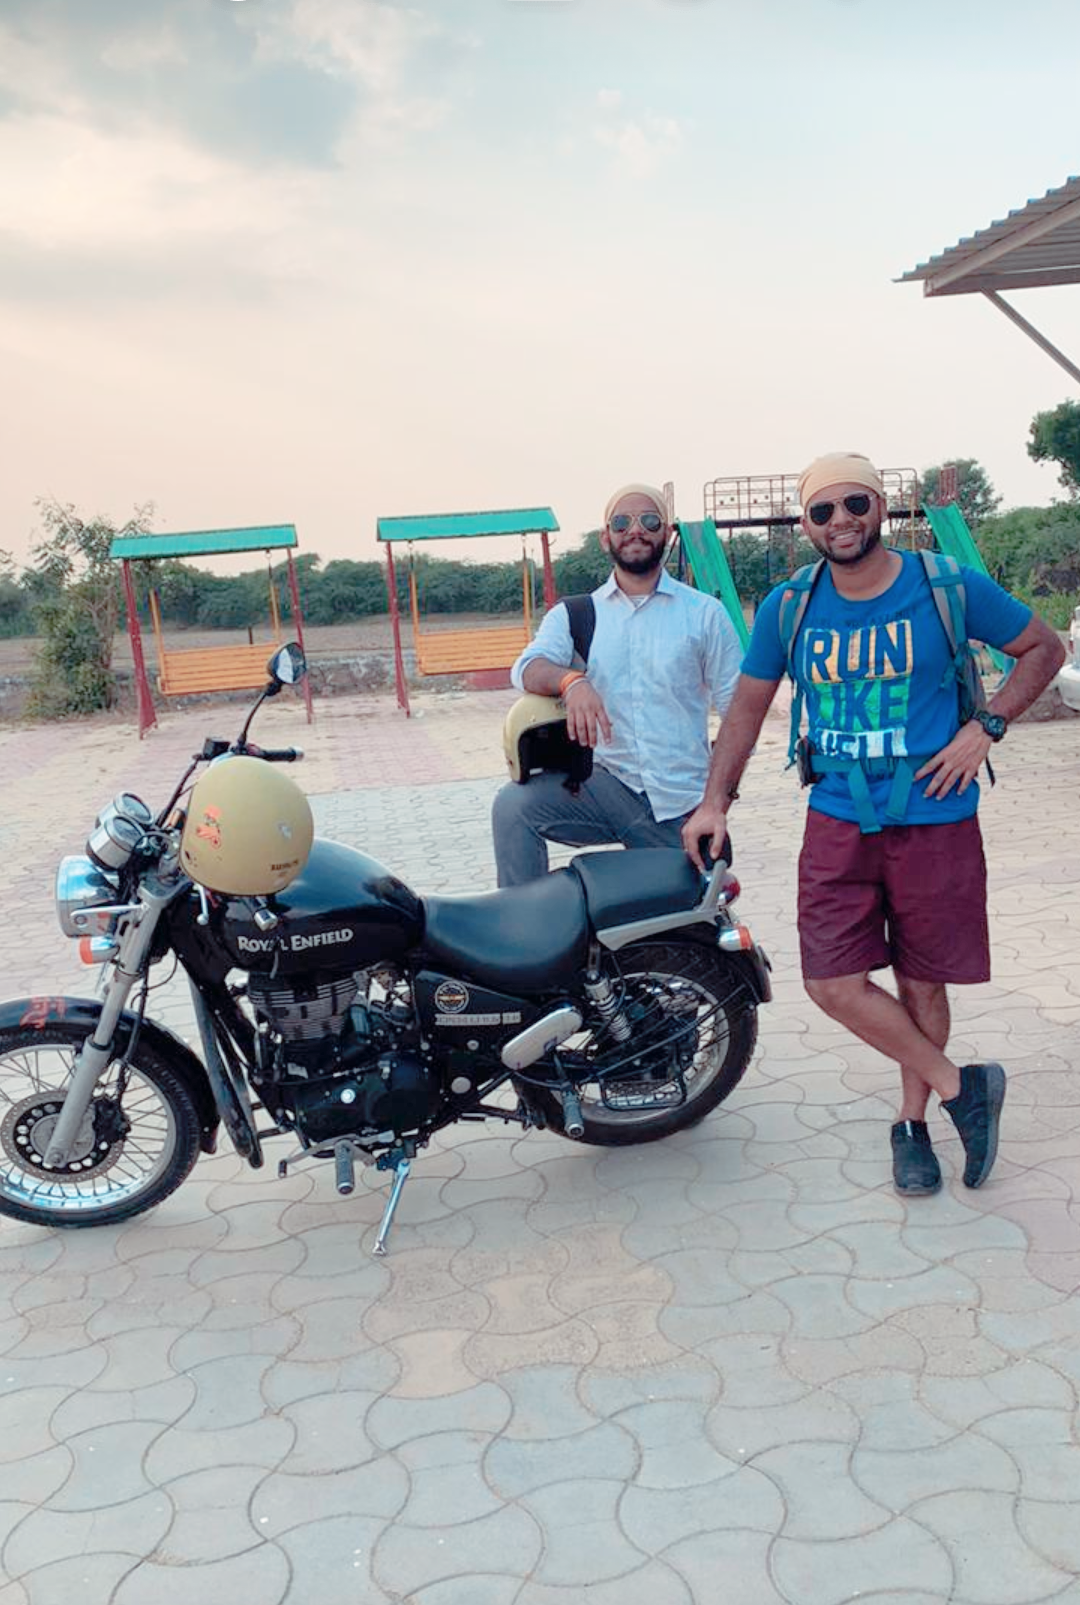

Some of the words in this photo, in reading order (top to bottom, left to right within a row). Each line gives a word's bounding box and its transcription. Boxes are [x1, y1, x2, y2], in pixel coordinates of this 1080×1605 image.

[804, 620, 912, 684] RUN
[237, 936, 289, 953] ROYL
[290, 928, 354, 952] ENFIELD
